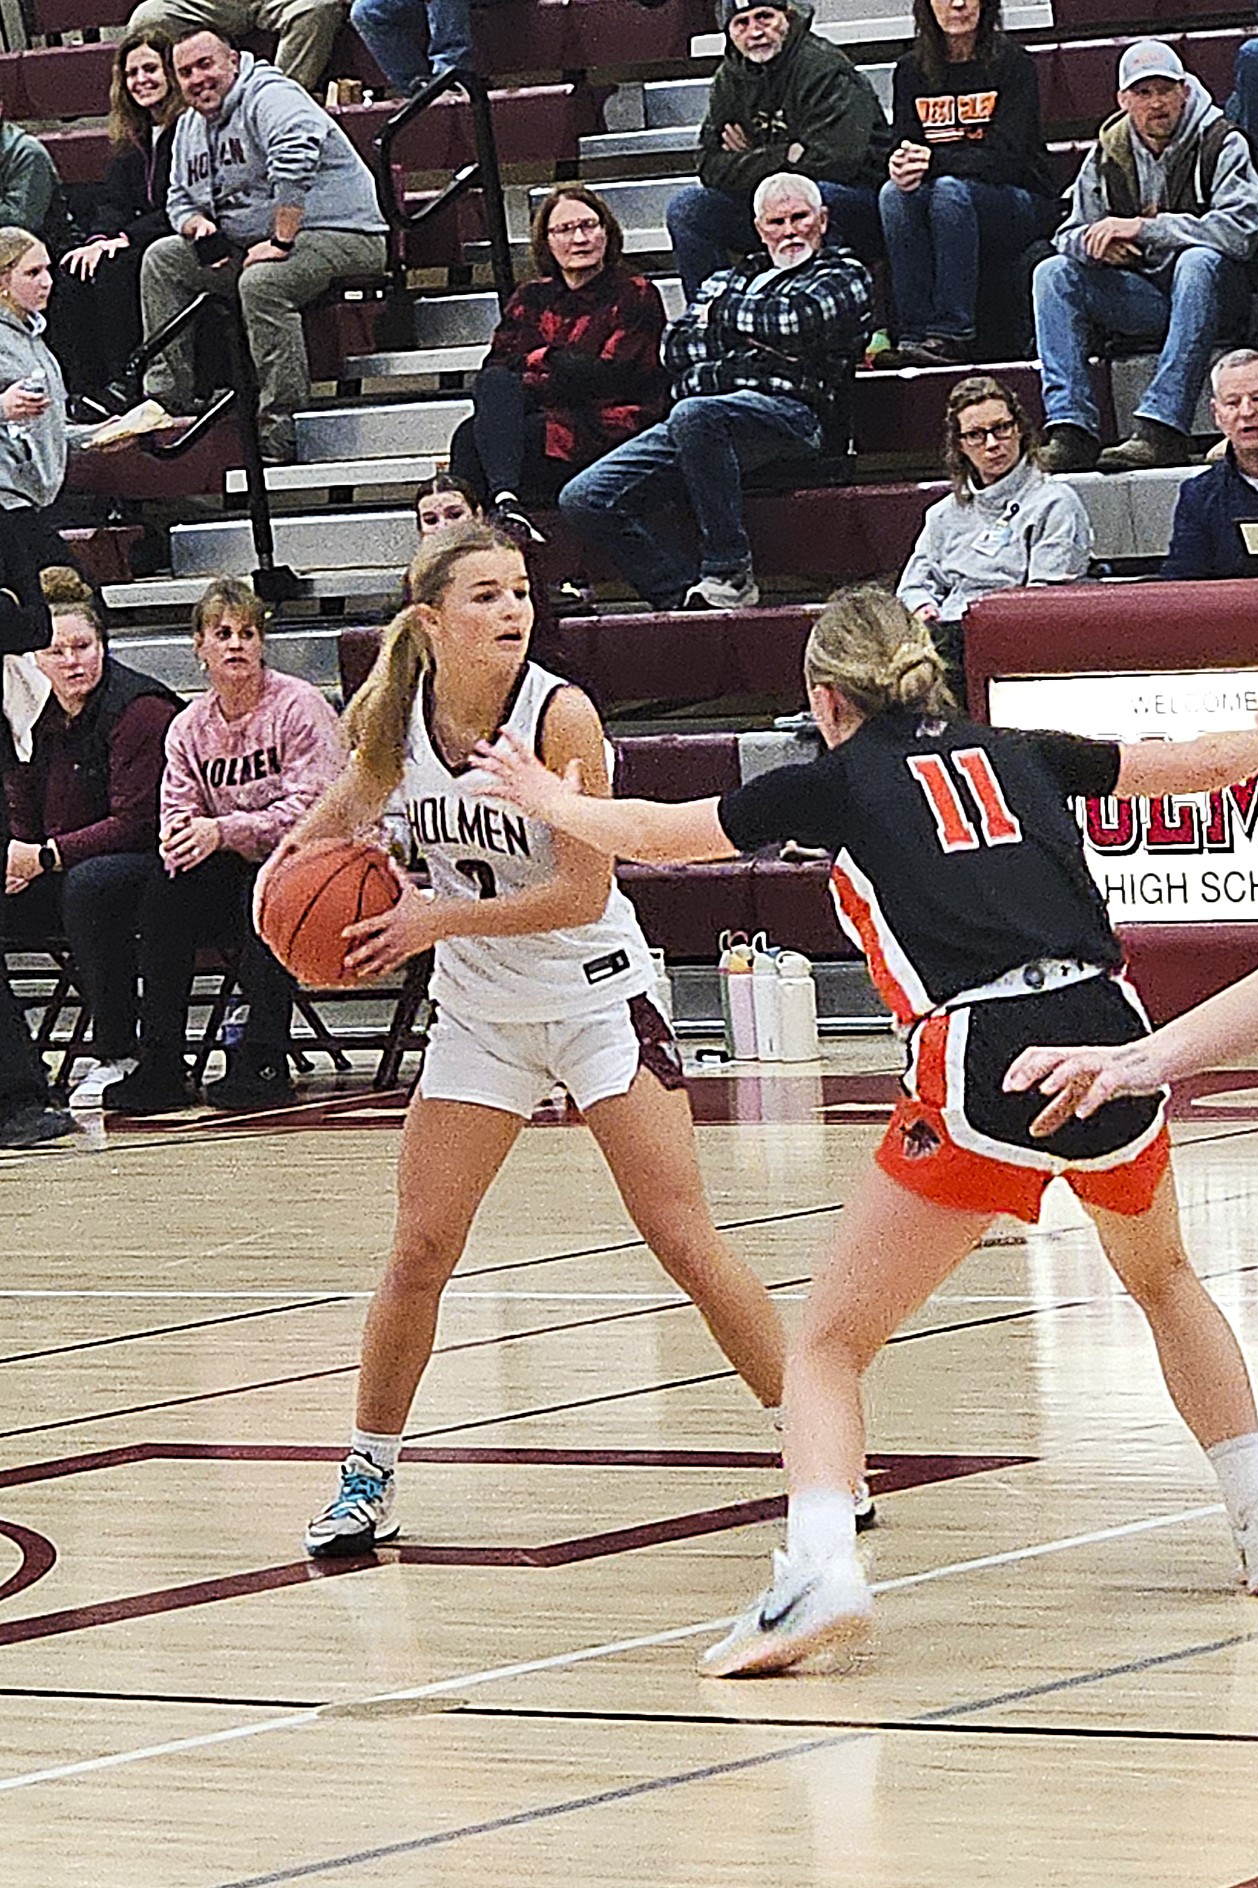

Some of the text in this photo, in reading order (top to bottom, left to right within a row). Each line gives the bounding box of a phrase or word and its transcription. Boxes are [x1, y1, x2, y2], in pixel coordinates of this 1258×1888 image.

[406, 795, 531, 858] HOLMEN
[906, 746, 1023, 854] 11
[1105, 872, 1188, 904] HIGH
